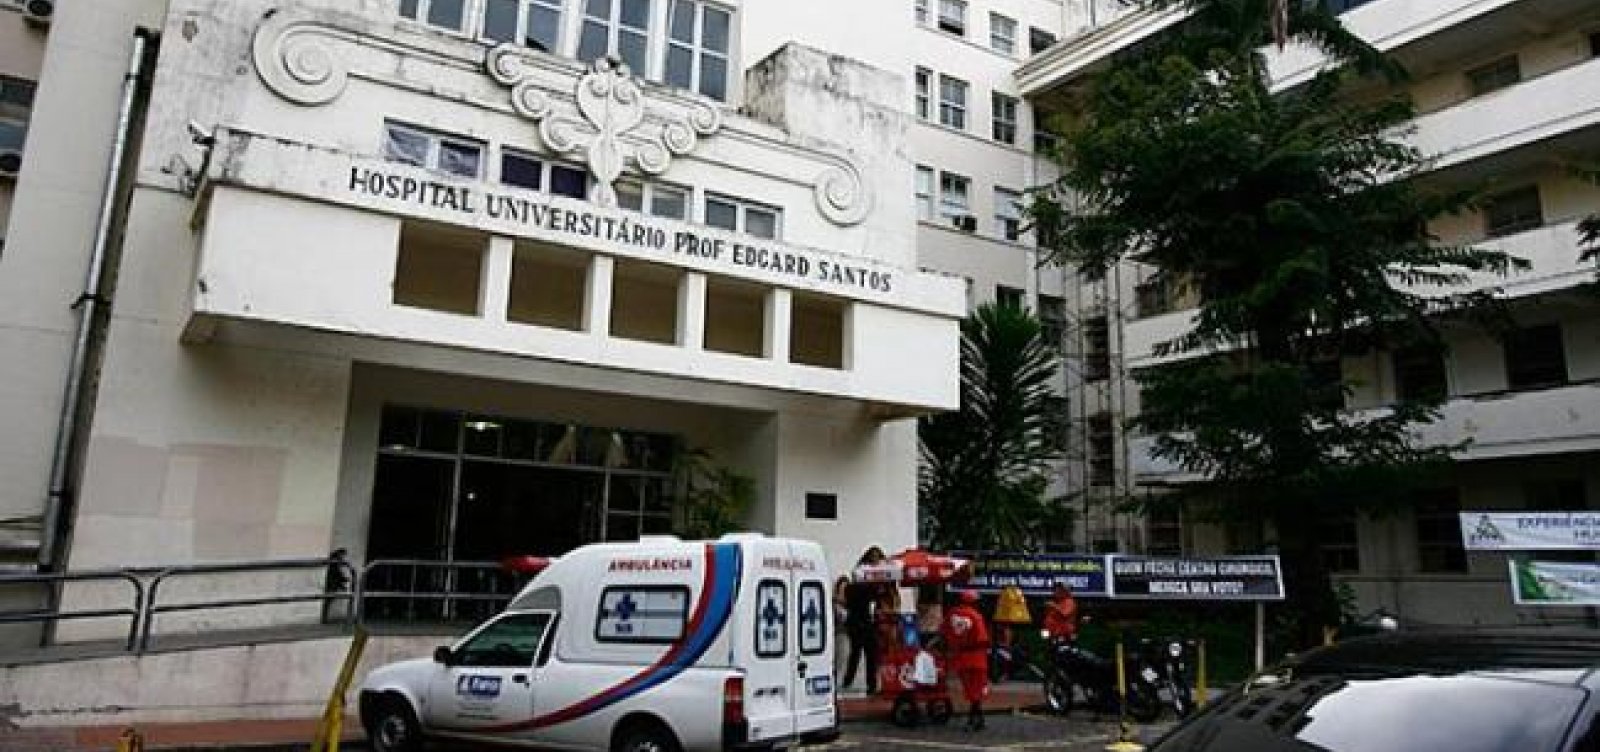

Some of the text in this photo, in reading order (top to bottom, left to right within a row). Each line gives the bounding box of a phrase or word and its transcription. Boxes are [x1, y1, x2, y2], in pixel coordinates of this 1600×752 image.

[350, 166, 891, 292] HOSPITAL UNIVERSITÁRIO PROF EDGARD SANTOS
